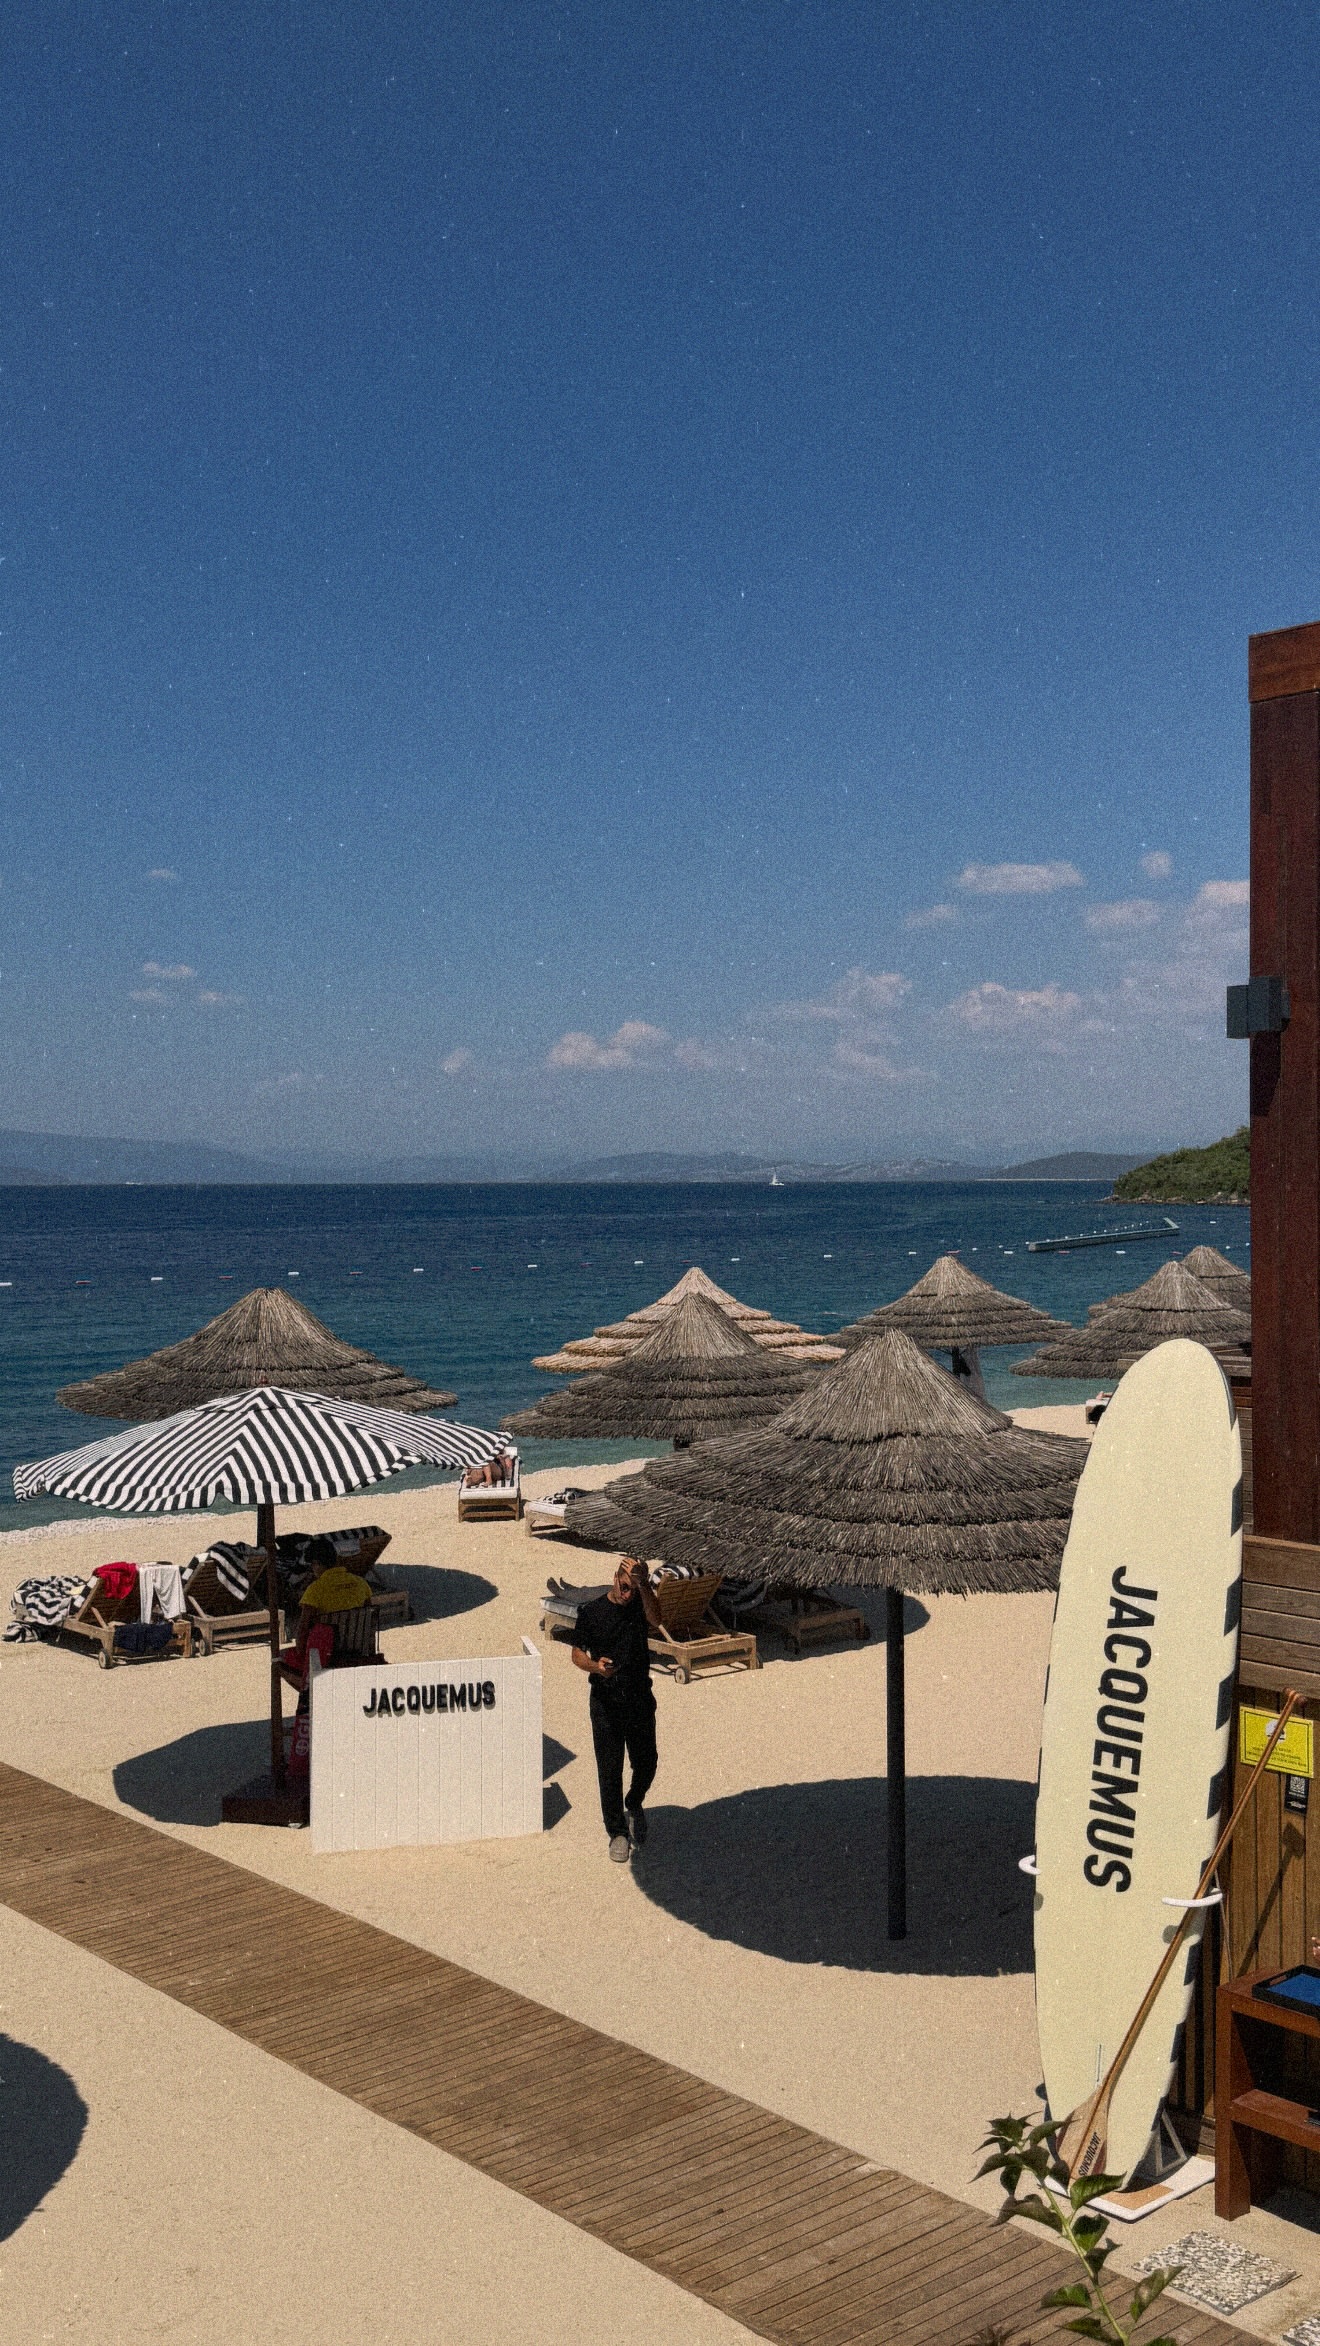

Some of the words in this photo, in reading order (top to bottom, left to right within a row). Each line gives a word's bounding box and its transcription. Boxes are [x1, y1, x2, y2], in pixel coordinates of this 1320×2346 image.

[362, 1680, 496, 1714] JACQUEMUS
[1083, 1565, 1158, 1892] JACQUEMUS
[1078, 2131, 1101, 2177] JACQUEMUS
